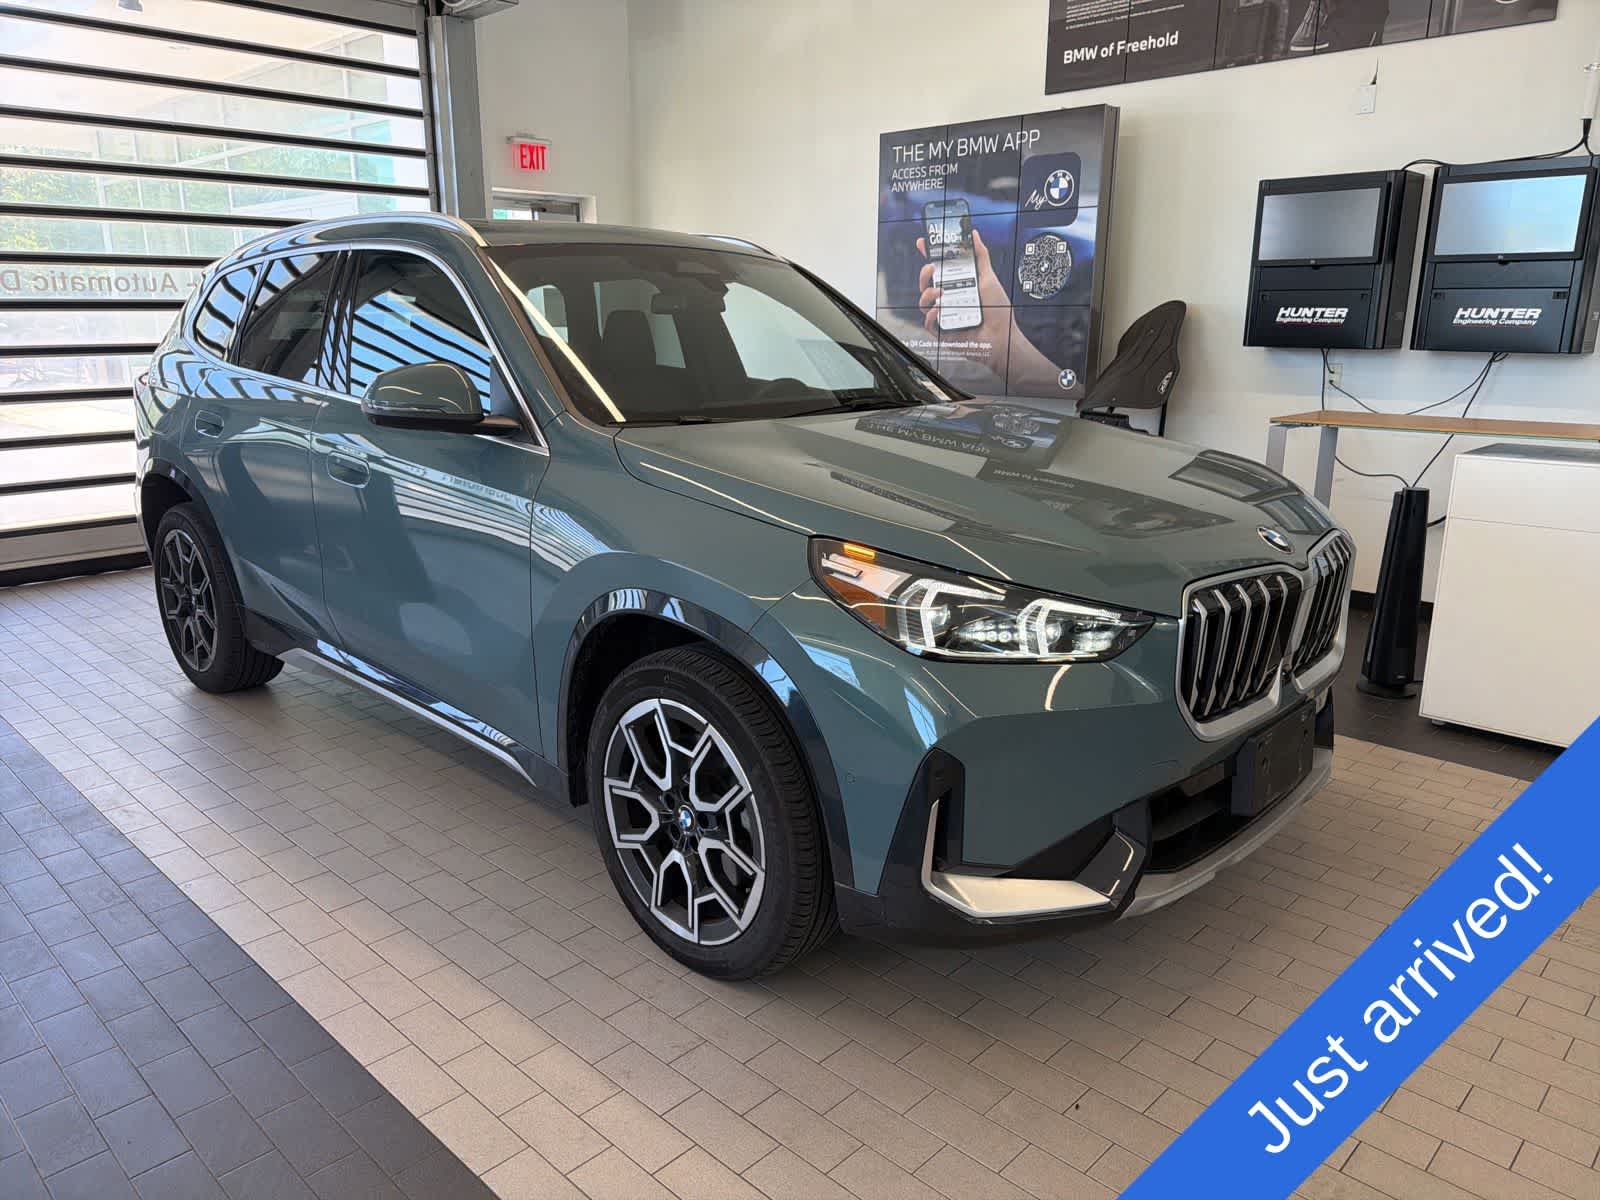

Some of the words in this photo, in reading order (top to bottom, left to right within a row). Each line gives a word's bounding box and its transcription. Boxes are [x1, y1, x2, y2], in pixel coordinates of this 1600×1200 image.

[1063, 45, 1098, 64] BMW
[1101, 43, 1114, 58] of
[1117, 30, 1179, 55] Freehold
[892, 143, 924, 164] THE
[929, 140, 954, 161] MY
[957, 134, 999, 157] BMW
[1003, 129, 1041, 152] APP
[520, 143, 546, 170] EXIT
[891, 166, 926, 180] ACCESS
[929, 163, 958, 177] FROM
[1278, 307, 1349, 318] HUNTER
[1455, 307, 1542, 319] HUNTER
[1453, 318, 1497, 326] Engineering
[1499, 318, 1537, 326] Company
[941, 340, 968, 348] download
